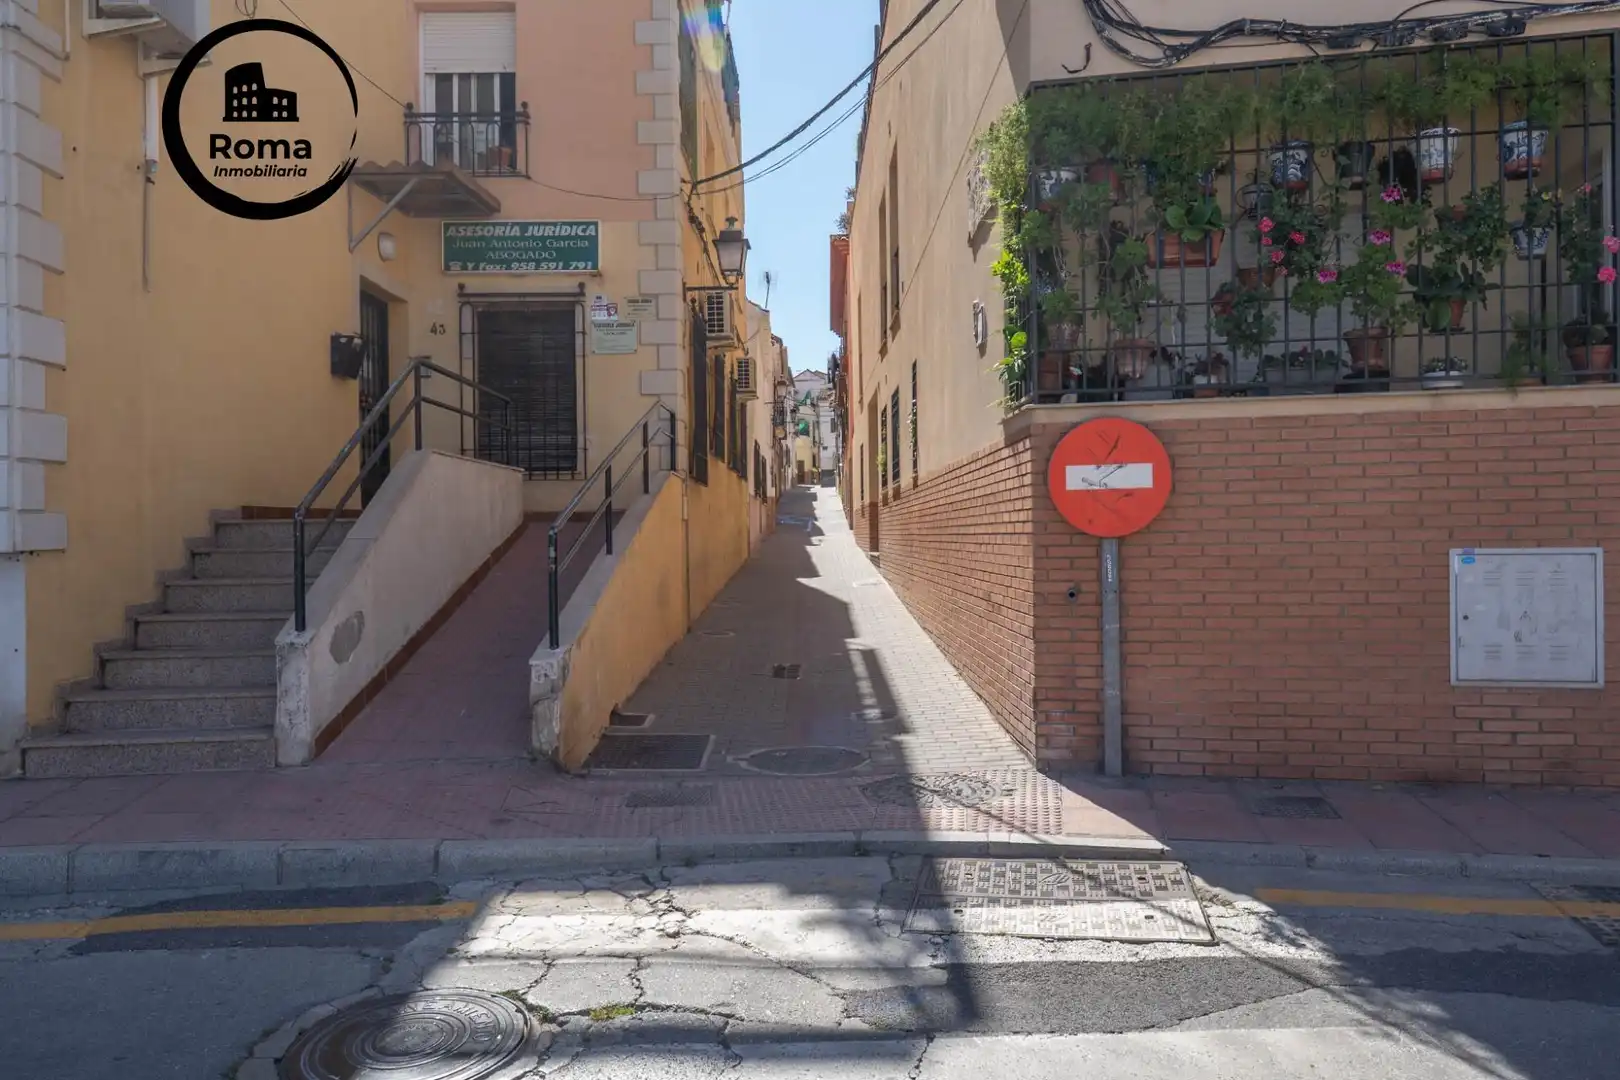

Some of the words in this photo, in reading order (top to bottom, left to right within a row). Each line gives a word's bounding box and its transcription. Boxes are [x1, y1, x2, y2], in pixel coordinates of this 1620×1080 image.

[446, 222, 520, 237] ASESORÍA
[524, 222, 596, 237] JURÍDICA
[453, 239, 485, 249] Juan
[488, 238, 542, 248] Antonio
[486, 251, 556, 259] ABOGADO
[511, 262, 535, 270] 958
[539, 262, 562, 270] 591
[569, 262, 592, 270] 791
